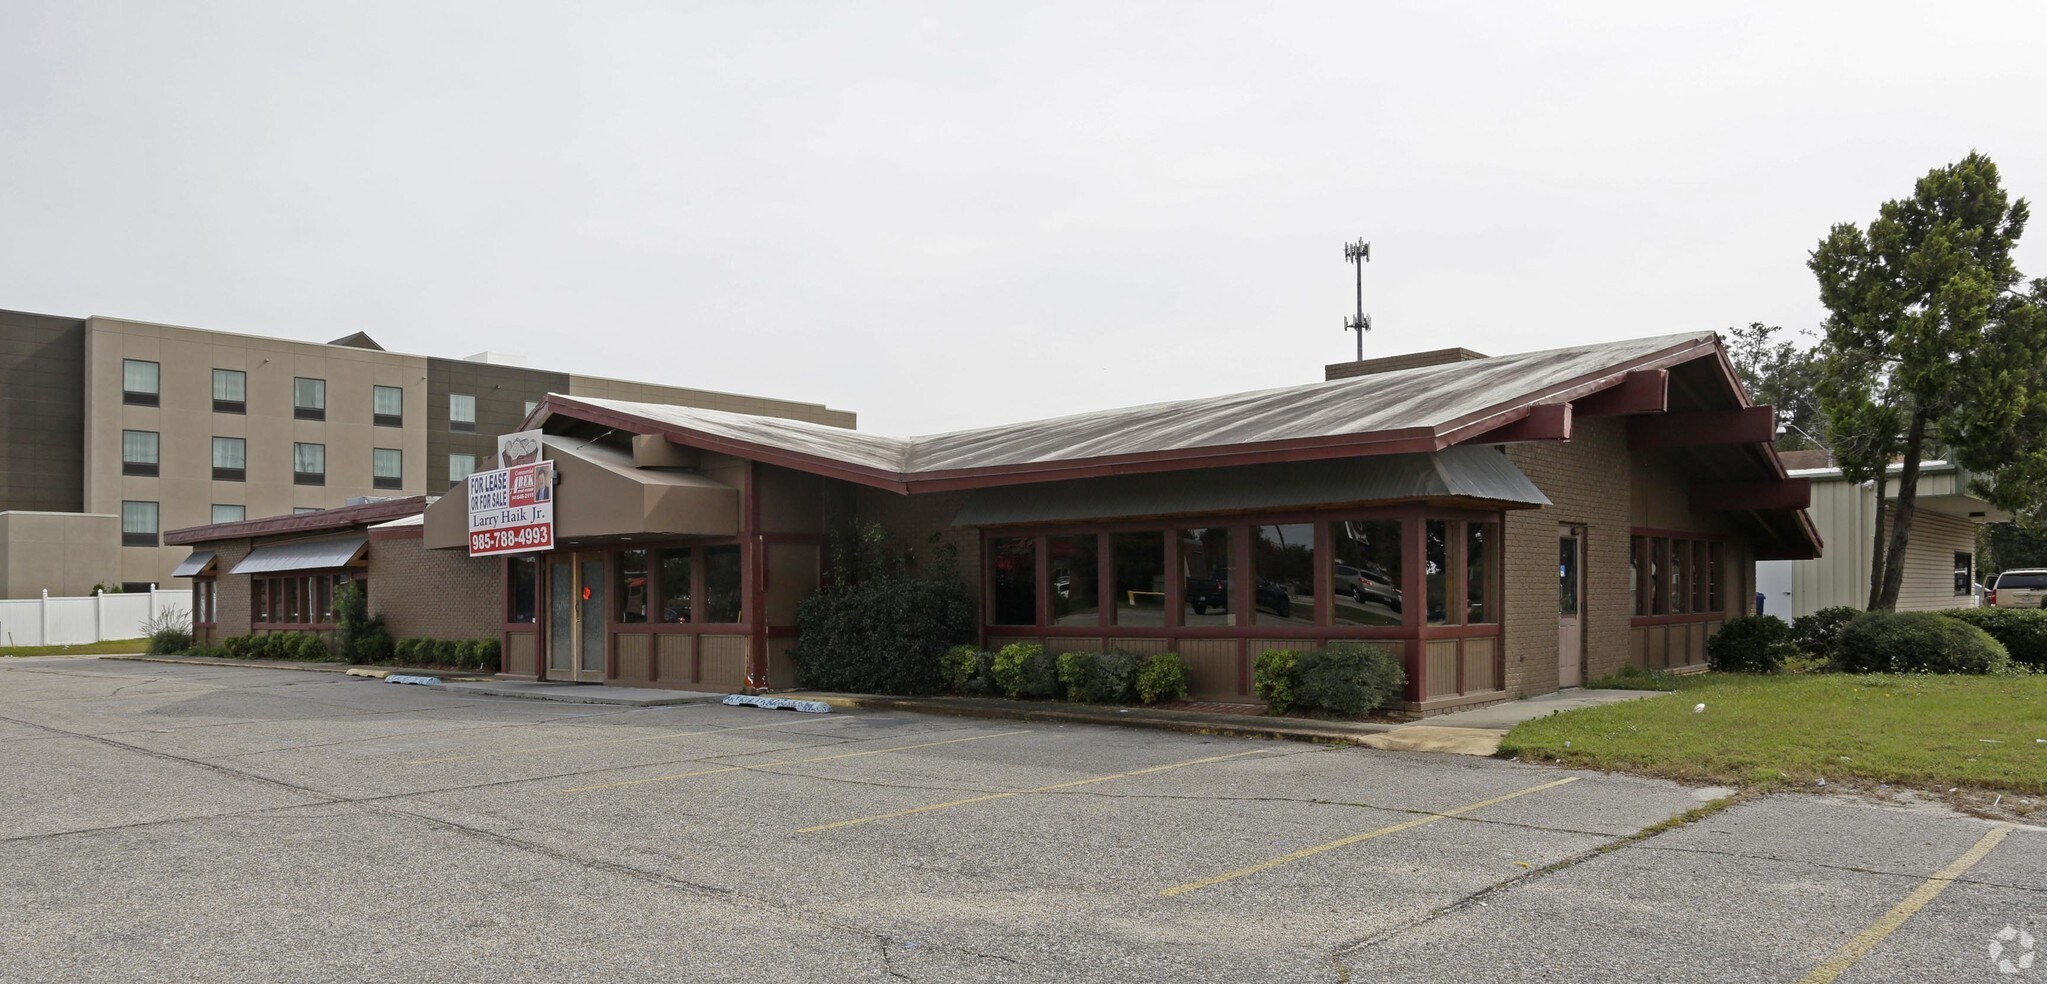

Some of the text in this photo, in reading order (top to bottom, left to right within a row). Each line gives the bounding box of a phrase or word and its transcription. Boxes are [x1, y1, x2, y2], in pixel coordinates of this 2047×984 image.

[471, 473, 506, 494] FOR LEASE
[471, 491, 506, 511] OR FOR SALE
[473, 507, 545, 528] Larry Haik Jr.
[472, 526, 548, 550] 985-788-4993
